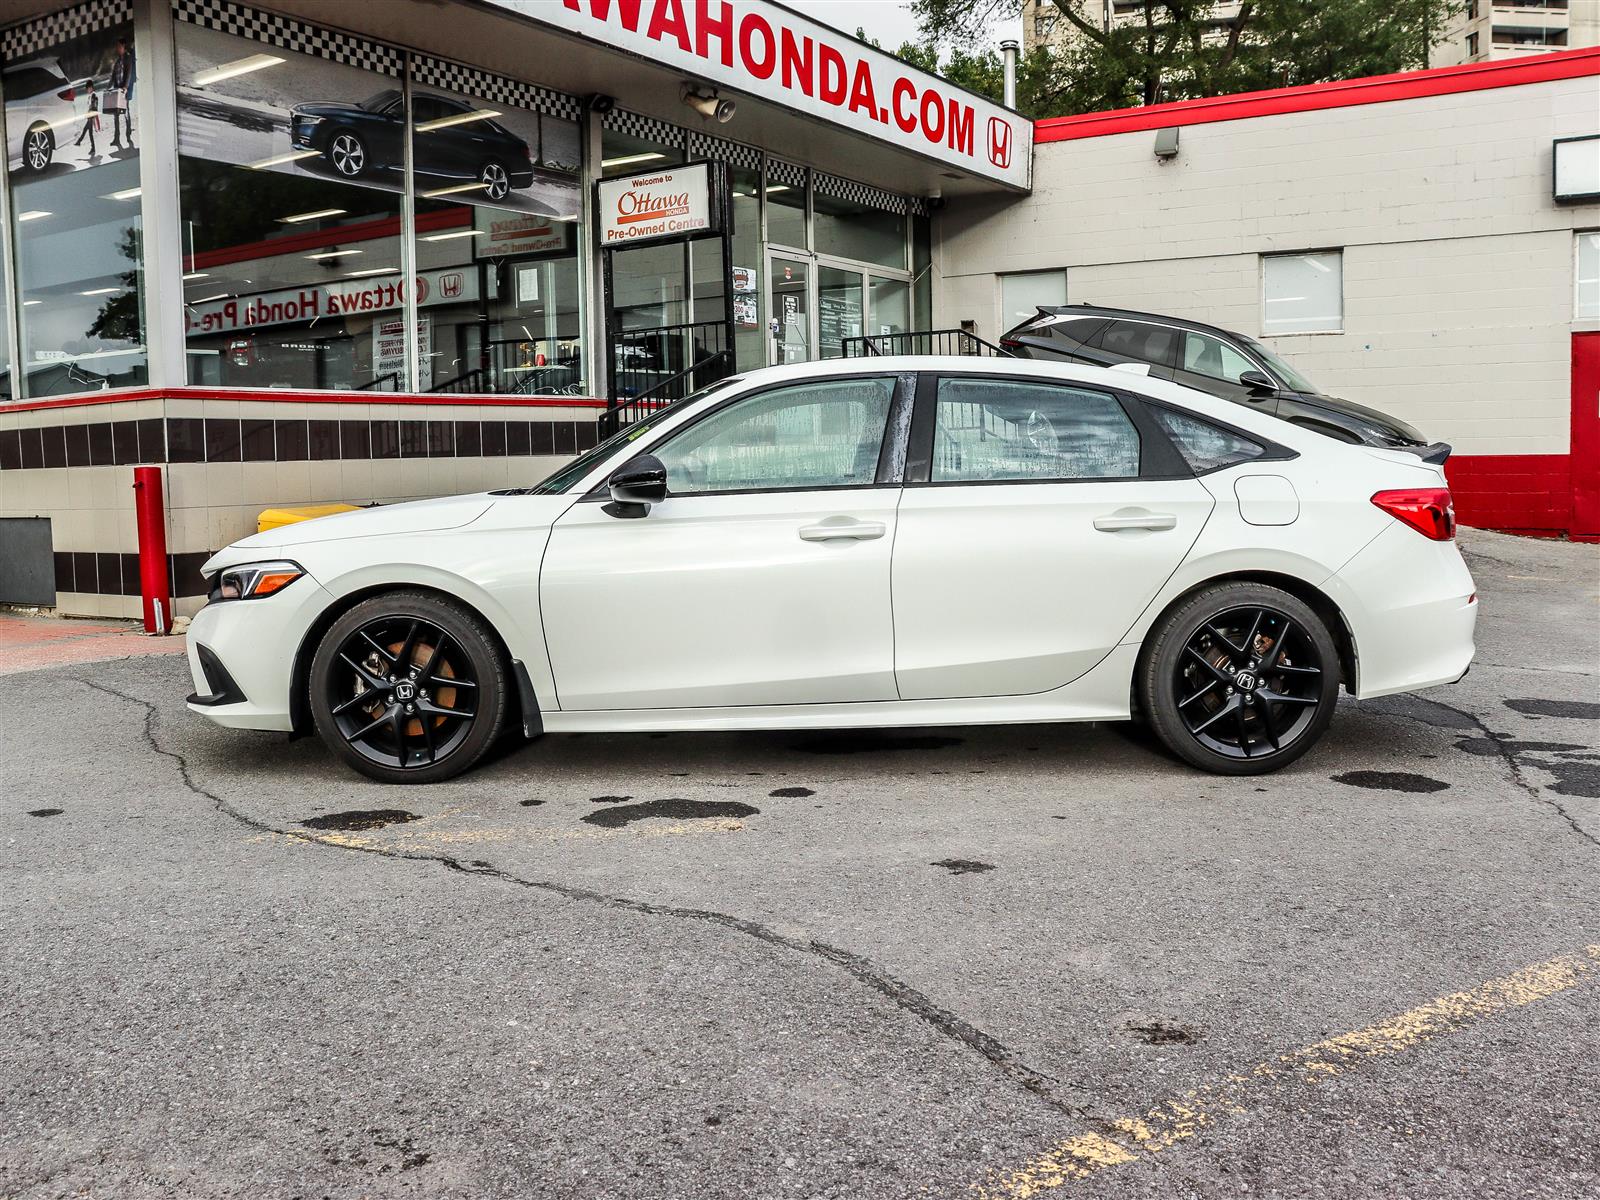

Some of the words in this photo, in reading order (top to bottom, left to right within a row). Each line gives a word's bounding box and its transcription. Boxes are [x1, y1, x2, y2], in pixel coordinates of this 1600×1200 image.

[562, 0, 975, 157] AHONDA.COM
[632, 177, 663, 188] Welcome
[617, 191, 689, 215] Ottawa
[665, 208, 688, 216] HONDA
[607, 222, 665, 240] Pre-Owned
[668, 217, 705, 231] Centre
